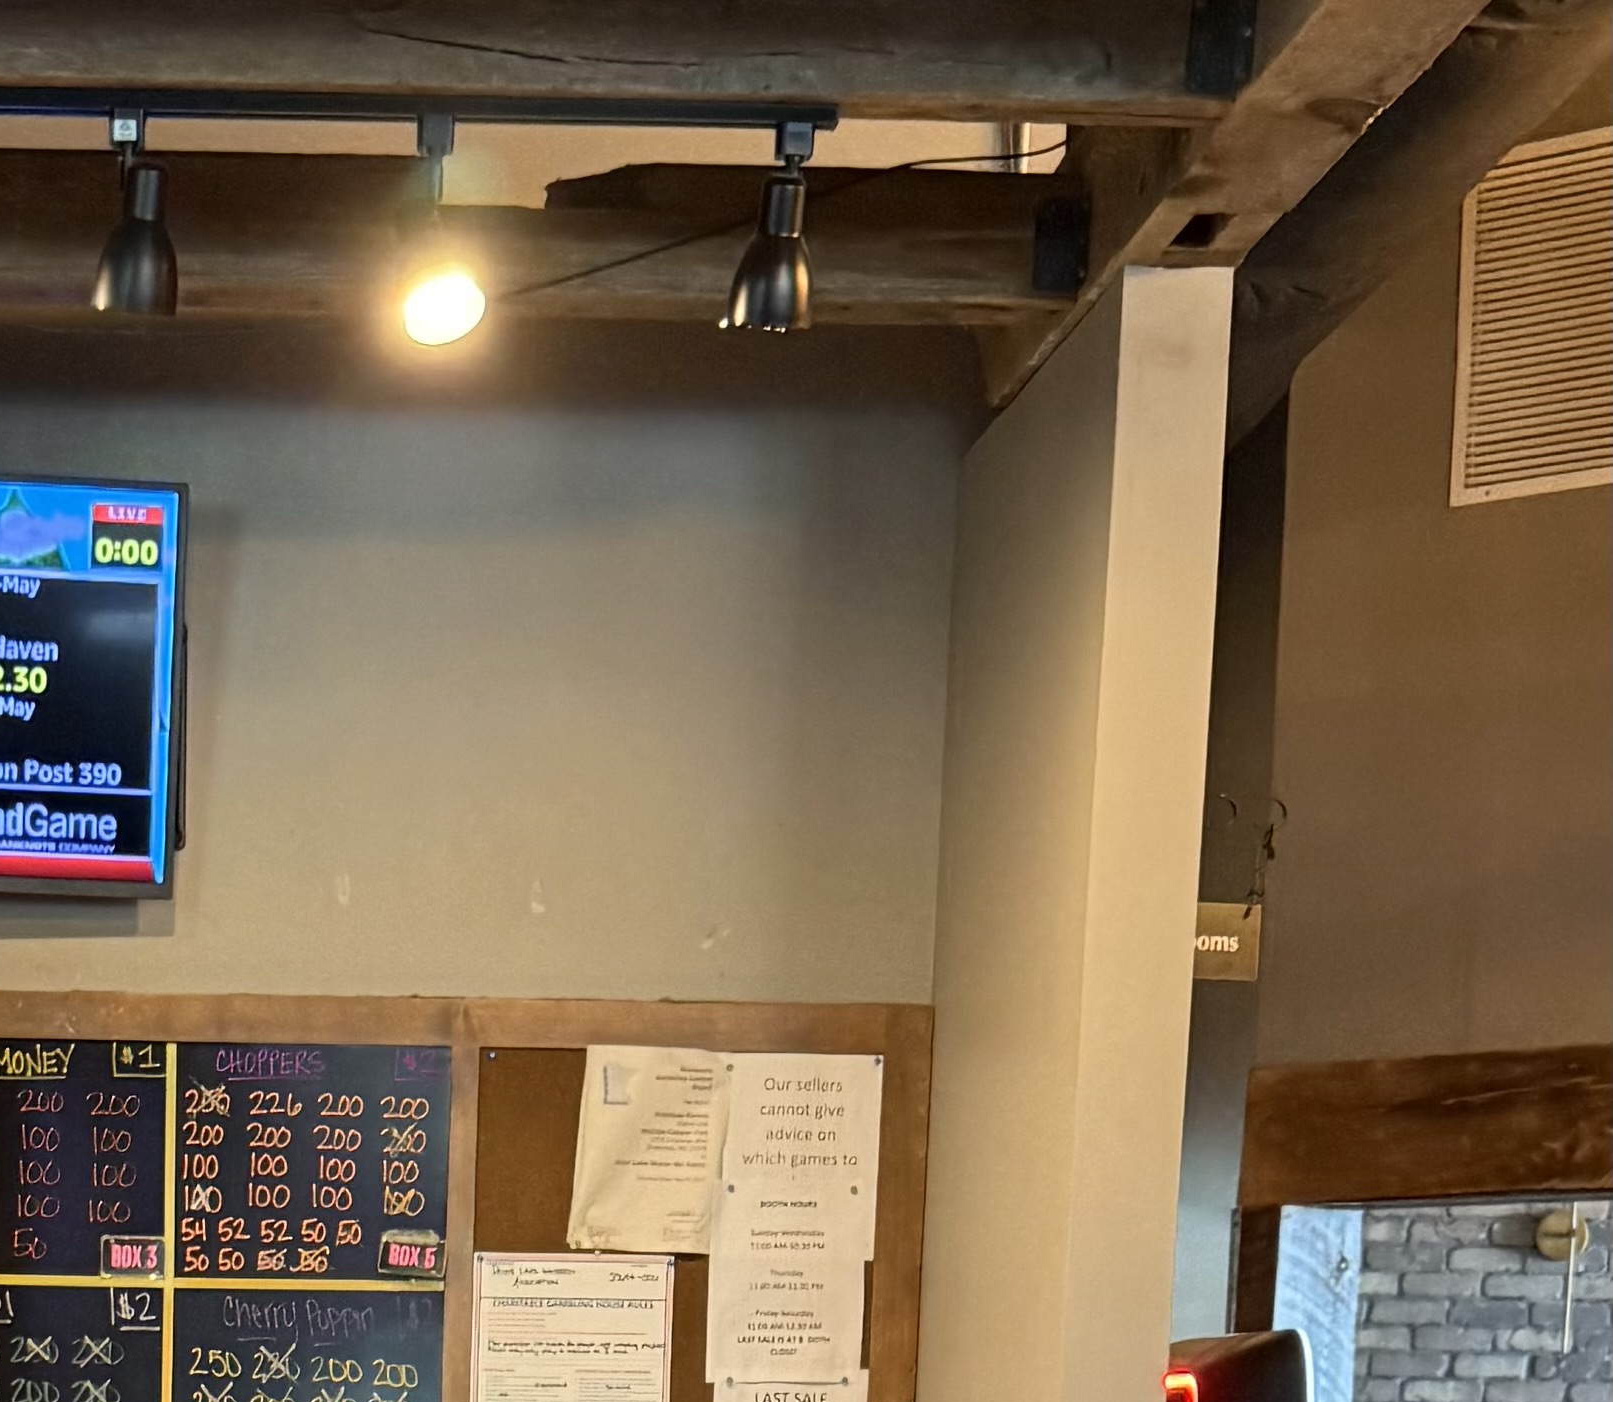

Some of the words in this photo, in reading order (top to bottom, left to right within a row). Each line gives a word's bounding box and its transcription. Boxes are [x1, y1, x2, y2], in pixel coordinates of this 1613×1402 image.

[94, 537, 158, 565] 0:00
[24, 759, 73, 784] Post
[78, 762, 122, 786] 390
[1194, 935, 1239, 952] oms
[216, 1049, 325, 1075] CHOPPERS
[764, 1077, 792, 1093] Our
[796, 1077, 843, 1093] sellers
[17, 1090, 64, 1113] 200
[86, 1092, 141, 1117] 200
[249, 1091, 303, 1117] 226
[318, 1093, 364, 1117] 200
[380, 1096, 429, 1120] 200
[760, 1103, 811, 1118] cannot
[815, 1104, 845, 1121] give
[766, 1128, 813, 1142] advice
[818, 1131, 837, 1142] on
[742, 1152, 786, 1167] which
[790, 1154, 838, 1169] games
[843, 1153, 858, 1167] to
[111, 1246, 141, 1268] BOX
[145, 1245, 157, 1267] 3
[389, 1245, 420, 1267] BOX
[424, 1247, 437, 1269] 5
[116, 1292, 156, 1321] $2
[223, 1296, 298, 1345] Cherry
[189, 1347, 242, 1377] 250
[311, 1357, 363, 1382] 200
[372, 1359, 418, 1387] 200
